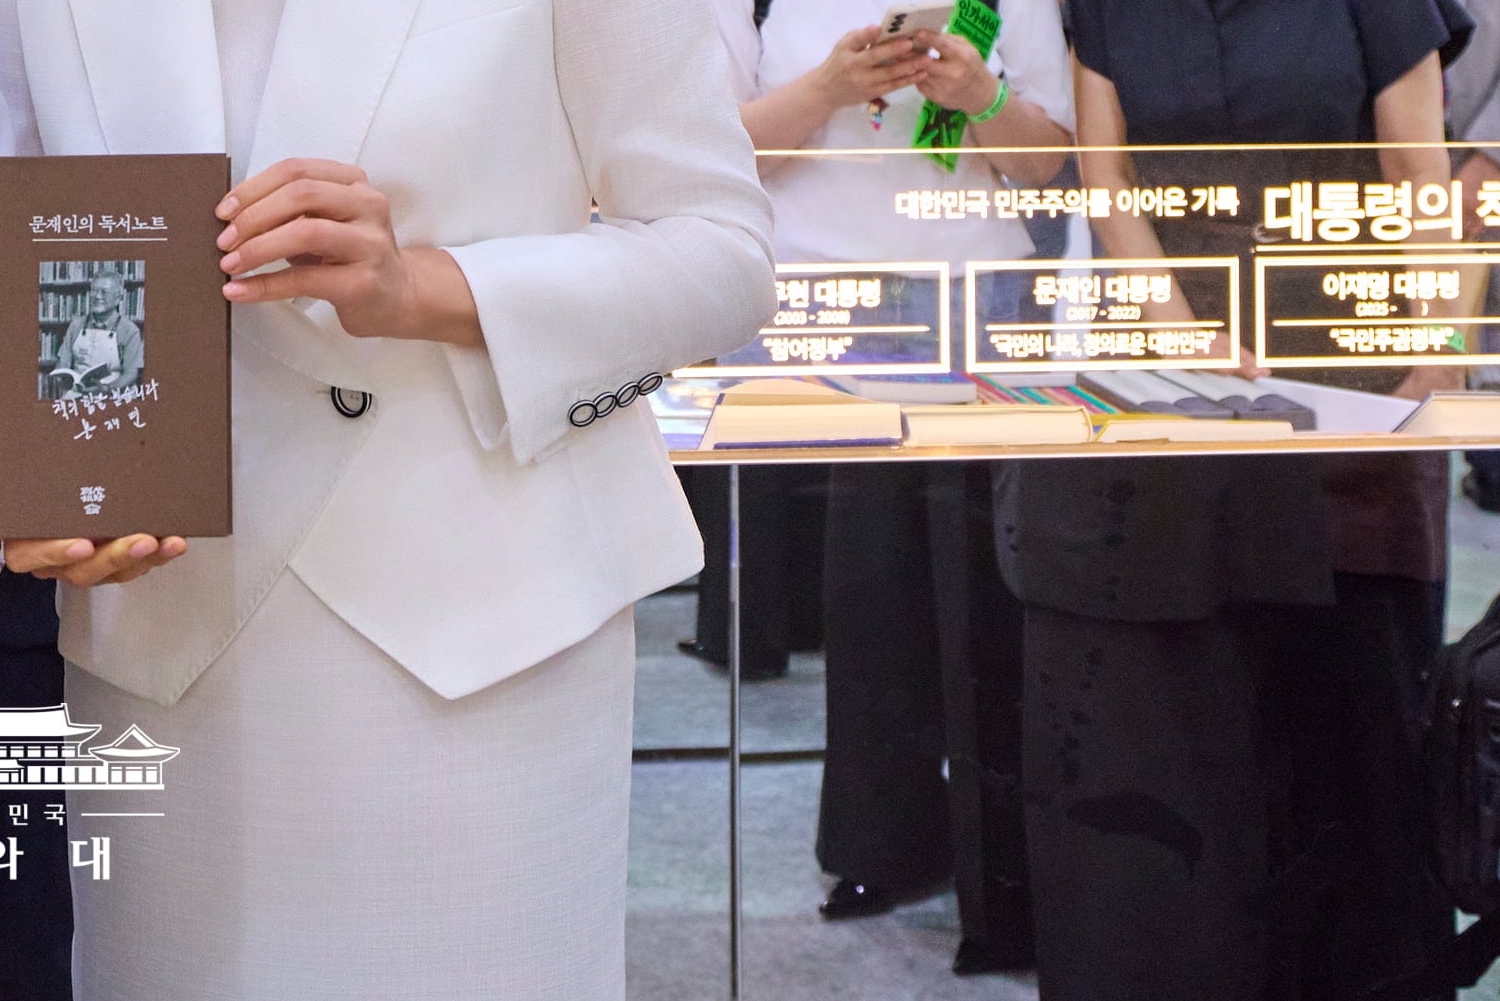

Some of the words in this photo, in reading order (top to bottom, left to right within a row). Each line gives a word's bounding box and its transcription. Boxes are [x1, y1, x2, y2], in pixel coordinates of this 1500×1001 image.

[895, 189, 990, 219] 대한민국
[994, 188, 1112, 218] 민주주의를
[1191, 186, 1240, 216] 기록
[1264, 181, 1463, 242] 대통령의
[29, 214, 94, 234] 문재인의
[98, 214, 168, 233] 독서노트
[814, 279, 881, 308] 대통령
[1105, 275, 1171, 303] 대통령
[1323, 271, 1389, 300] 이재명
[1393, 271, 1459, 300] 대통령
